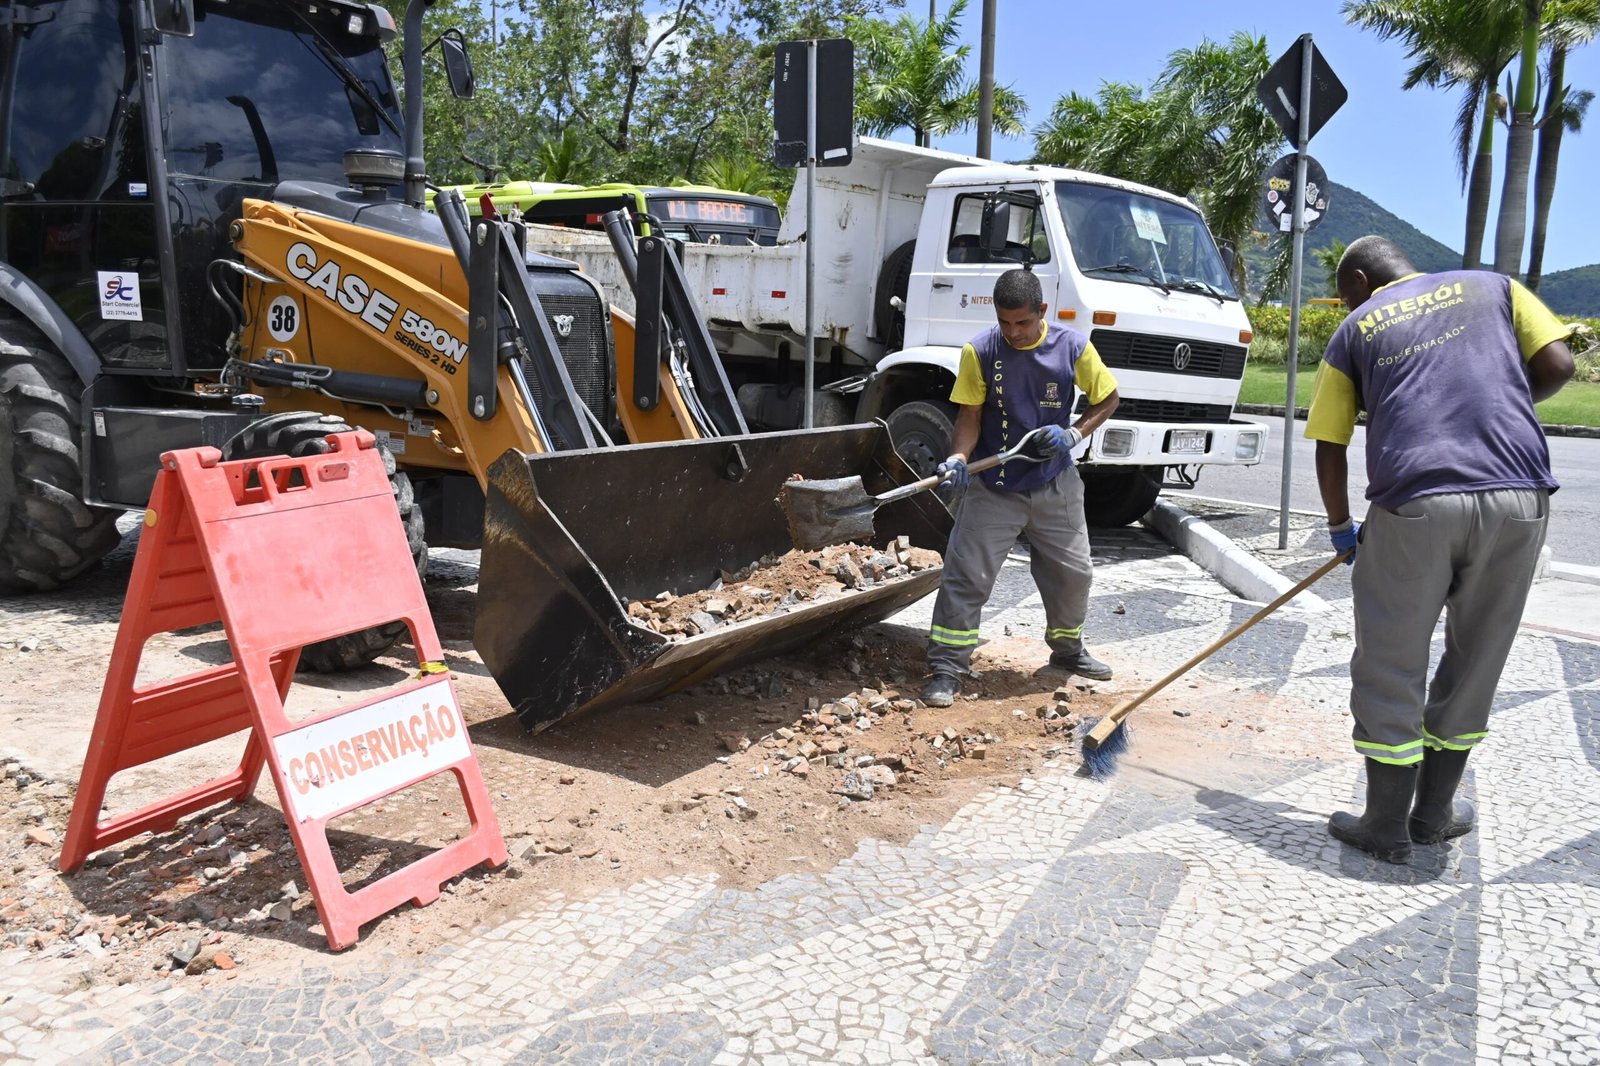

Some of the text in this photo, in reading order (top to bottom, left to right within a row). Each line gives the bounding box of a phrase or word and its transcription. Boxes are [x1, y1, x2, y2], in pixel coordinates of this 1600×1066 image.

[697, 201, 746, 223] BARCAS
[286, 242, 399, 334] CASE
[971, 296, 994, 305] NITER
[1357, 282, 1462, 335] NITERÓI
[271, 304, 296, 332] 38
[400, 308, 469, 365] 580N
[1372, 313, 1414, 335] FUTURO
[1424, 296, 1463, 315] AGORA
[394, 331, 457, 376] SERIES 2 HD
[289, 702, 456, 795] CONSERVAÇÃO
